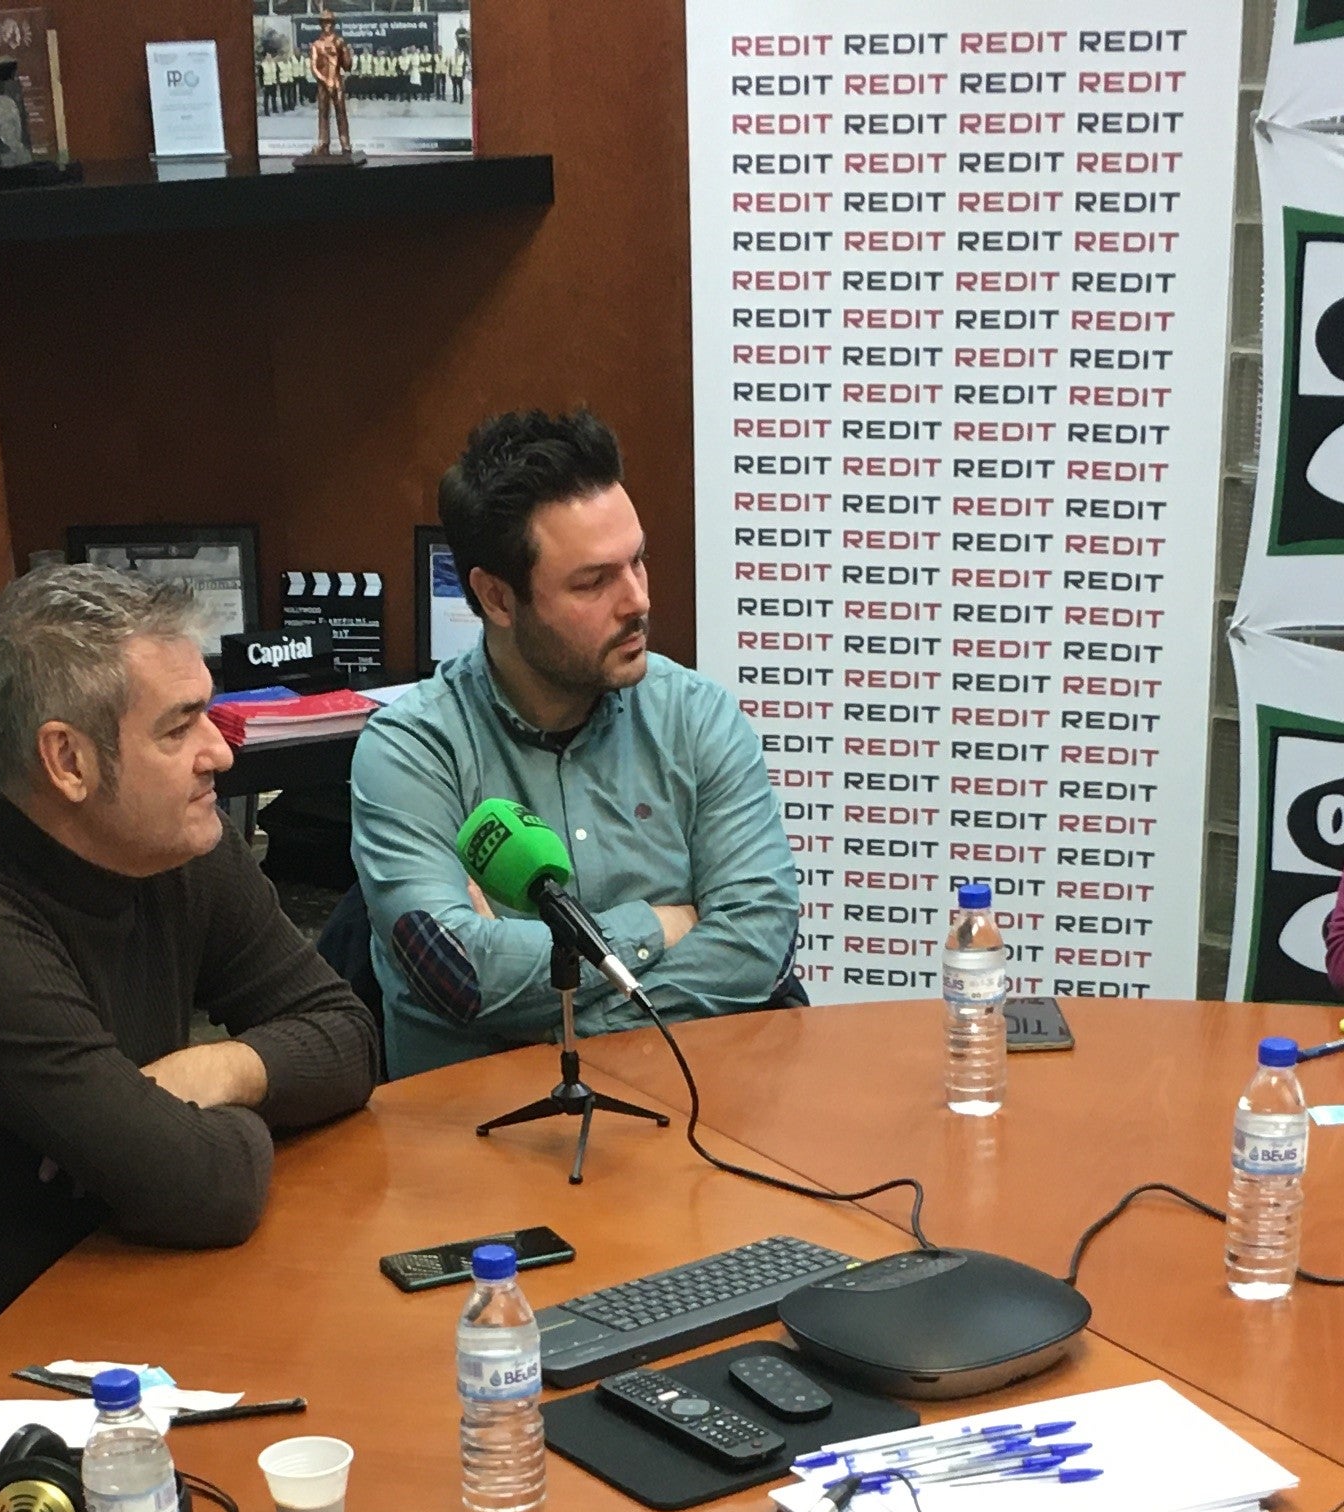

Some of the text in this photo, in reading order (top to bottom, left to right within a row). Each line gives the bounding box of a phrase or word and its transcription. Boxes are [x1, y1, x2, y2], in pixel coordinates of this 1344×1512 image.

[732, 30, 1187, 56] REDIT REDIT REDIT REDIT
[732, 71, 1186, 96] REDIT REDIT REDIT REDIT
[733, 112, 1184, 135] REDIT REDIT REDIT REDIT
[733, 152, 1183, 174] REDIT REDIT REDIT REDIT
[733, 192, 1181, 213] REDIT REDIT REDIT REDIT
[733, 231, 1179, 253] REDIT REDIT REDIT REDIT
[733, 271, 1176, 294] REDIT REDIT REDIT REDIT
[733, 308, 1175, 332] REDIT REDIT REDIT REDIT
[734, 345, 1173, 370] REDIT REDIT REDIT REDIT
[733, 382, 1171, 407] REDIT REDIT REDIT REDIT
[734, 419, 1170, 445] REDIT REDIT REDIT REDIT
[734, 455, 1169, 482] REDIT REDIT REDIT REDIT
[735, 493, 1167, 521] REDIT REDIT REDIT REDIT
[735, 527, 1166, 556] REDIT REDIT REDIT REDIT
[736, 562, 1164, 593] REDIT REDIT REDIT REDIT
[738, 598, 1165, 628] REDIT REDIT REDIT REDIT
[247, 635, 313, 667] Capital
[738, 632, 1163, 663] REDIT REDIT REDIT REDIT
[739, 666, 1162, 698] REDIT REDIT REDIT REDIT
[739, 700, 1160, 733] REDIT REDIT REDIT REDIT
[762, 734, 1159, 767] EDIT REDIT REDIT REDIT
[767, 769, 1158, 802] EDIT REDIT REDIT REDIT
[785, 803, 1157, 835] DIT REDIT REDIT REDIT
[786, 835, 1155, 869] DIT REDIT REDIT REDIT
[845, 871, 939, 891] REDIT
[1057, 881, 1154, 902] REDIT
[844, 904, 938, 924] REDIT
[1056, 915, 1153, 936] REDIT
[844, 936, 938, 956] REDIT
[1056, 948, 1152, 968] REDIT
[844, 967, 937, 988] REDIT
[1054, 979, 1150, 999] REDIT
[1261, 1148, 1297, 1162] BEJIS
